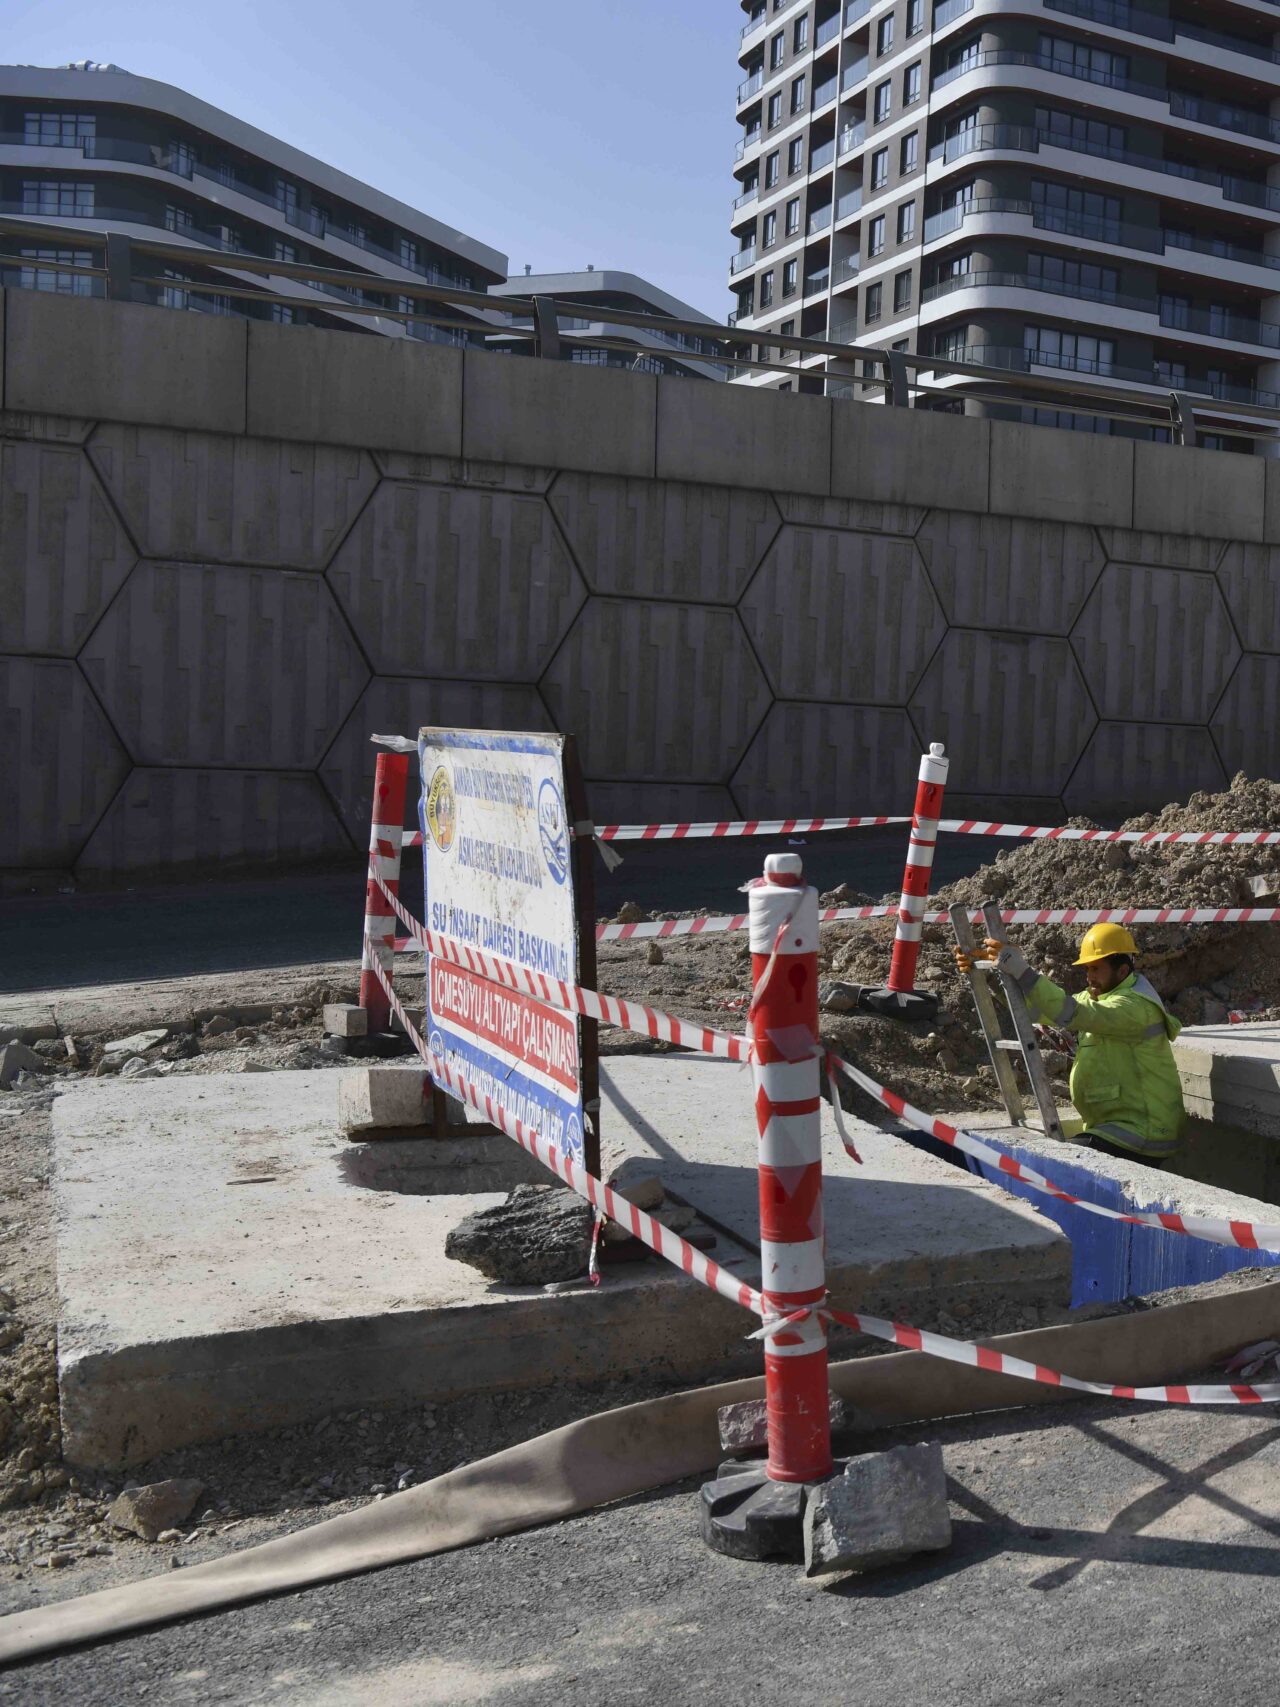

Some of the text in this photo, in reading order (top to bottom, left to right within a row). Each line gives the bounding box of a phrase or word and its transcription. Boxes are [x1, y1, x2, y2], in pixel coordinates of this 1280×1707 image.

[473, 839, 497, 874] GENEL
[432, 901, 568, 984] SU İNŞAAT DAİRESİ BAŞKANLIĞI
[434, 960, 575, 1078] İÇMESUYU ALTYAPI ÇALIŞMASI
